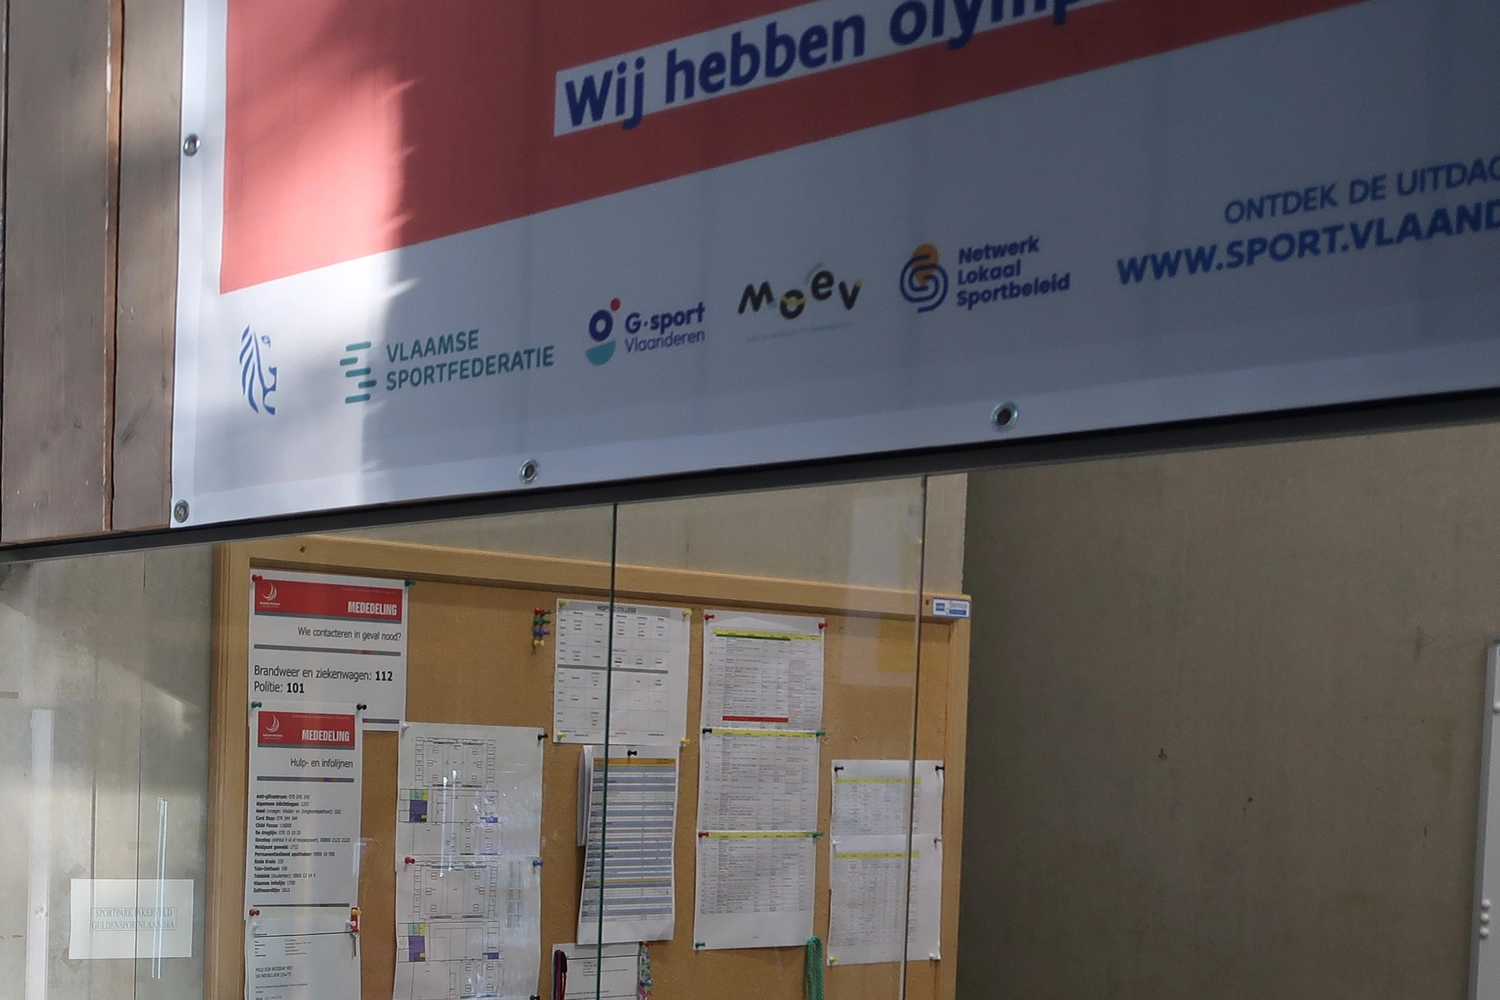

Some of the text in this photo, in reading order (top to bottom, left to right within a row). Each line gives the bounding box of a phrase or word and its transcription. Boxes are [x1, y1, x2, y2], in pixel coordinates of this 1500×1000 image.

[565, 56, 645, 130] Wij
[666, 14, 865, 104] hebben
[1224, 183, 1339, 224] ONTDEK
[1349, 174, 1387, 205] DE
[958, 235, 1039, 265] Netwerk
[958, 259, 1021, 285] Lokaal
[957, 272, 1071, 310] Sportbeleid
[386, 328, 479, 363] VLAAMSE
[625, 329, 705, 353] Vlaanderen
[386, 345, 554, 392] SPORTFEDERATIE
[348, 601, 397, 615] MEDEDELING
[298, 627, 401, 641] Wie contacteren in geval nood?
[254, 665, 392, 682] Brandweer en ziekenwagen: 112
[254, 681, 304, 693] Politie: 101
[302, 730, 349, 742] MEDEDELING
[291, 758, 308, 767] Hulp-
[322, 759, 353, 769] infolijnen
